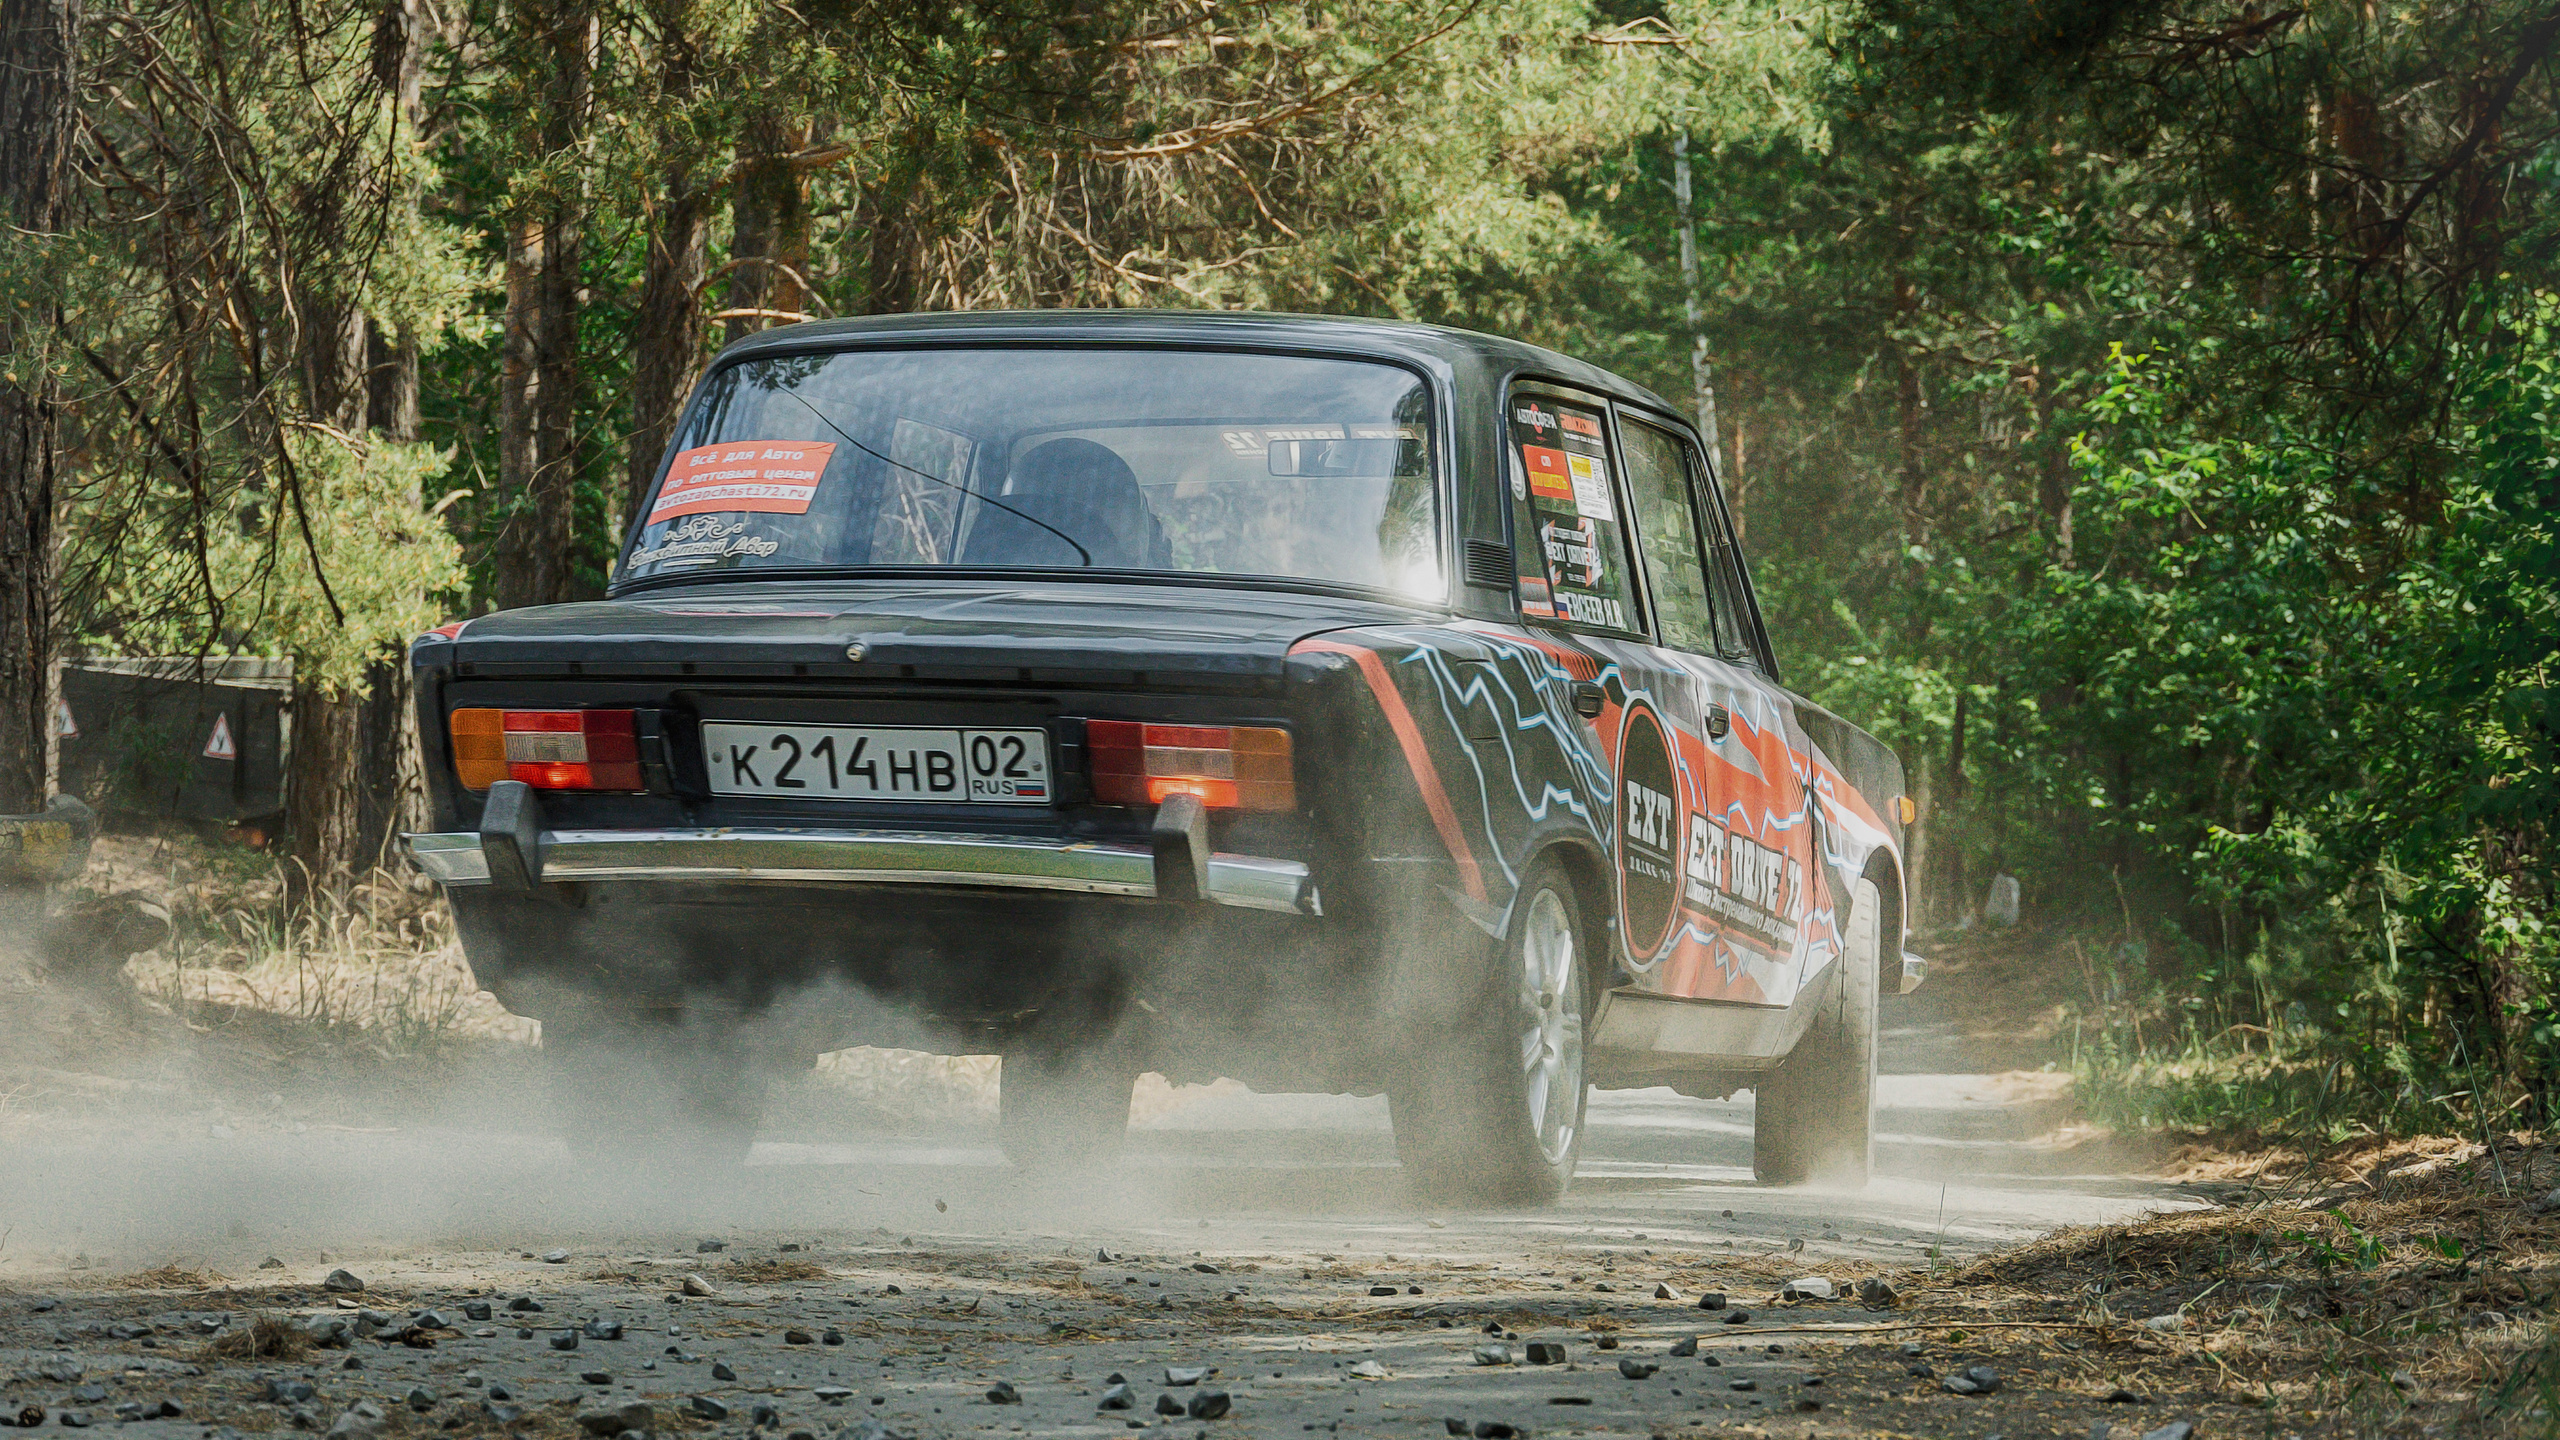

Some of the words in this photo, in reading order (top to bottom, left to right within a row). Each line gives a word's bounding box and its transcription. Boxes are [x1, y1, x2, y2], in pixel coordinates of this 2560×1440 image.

[688, 451, 719, 467] Всё
[722, 450, 756, 463] для
[761, 448, 804, 461] Авто
[665, 478, 684, 491] по
[689, 469, 757, 484] оптовым
[763, 469, 816, 481] ценам
[658, 485, 808, 509] avtozapchasti72.ru
[1564, 591, 1606, 626] ЕВСЕЕВ
[970, 735, 1029, 779] 02
[971, 779, 1015, 796] RUS
[1627, 779, 1671, 851] EXT
[1686, 813, 1725, 888] EXT
[1730, 834, 1783, 912] DRIVE
[1783, 858, 1802, 923] 72
